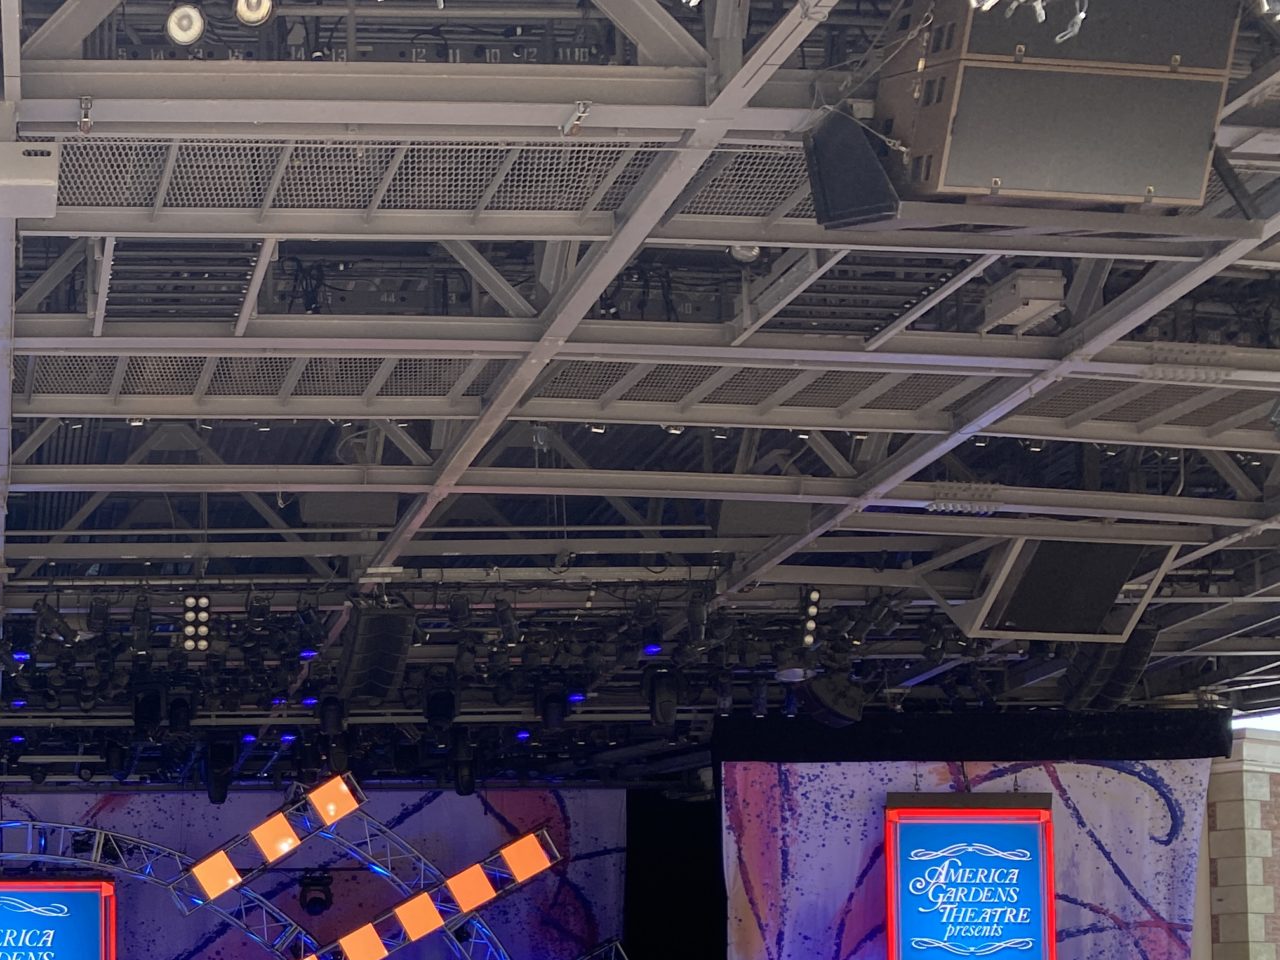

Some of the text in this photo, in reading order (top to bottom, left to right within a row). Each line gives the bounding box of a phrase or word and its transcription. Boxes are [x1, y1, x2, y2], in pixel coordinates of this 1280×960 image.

[412, 48, 426, 62] 12
[449, 48, 460, 62] 11
[485, 48, 500, 62] 10
[524, 48, 537, 61] 12
[909, 858, 1020, 895] AMERICA
[918, 884, 1020, 912] GARDENS
[939, 904, 1031, 923] THEATRE
[944, 922, 1003, 940] presents
